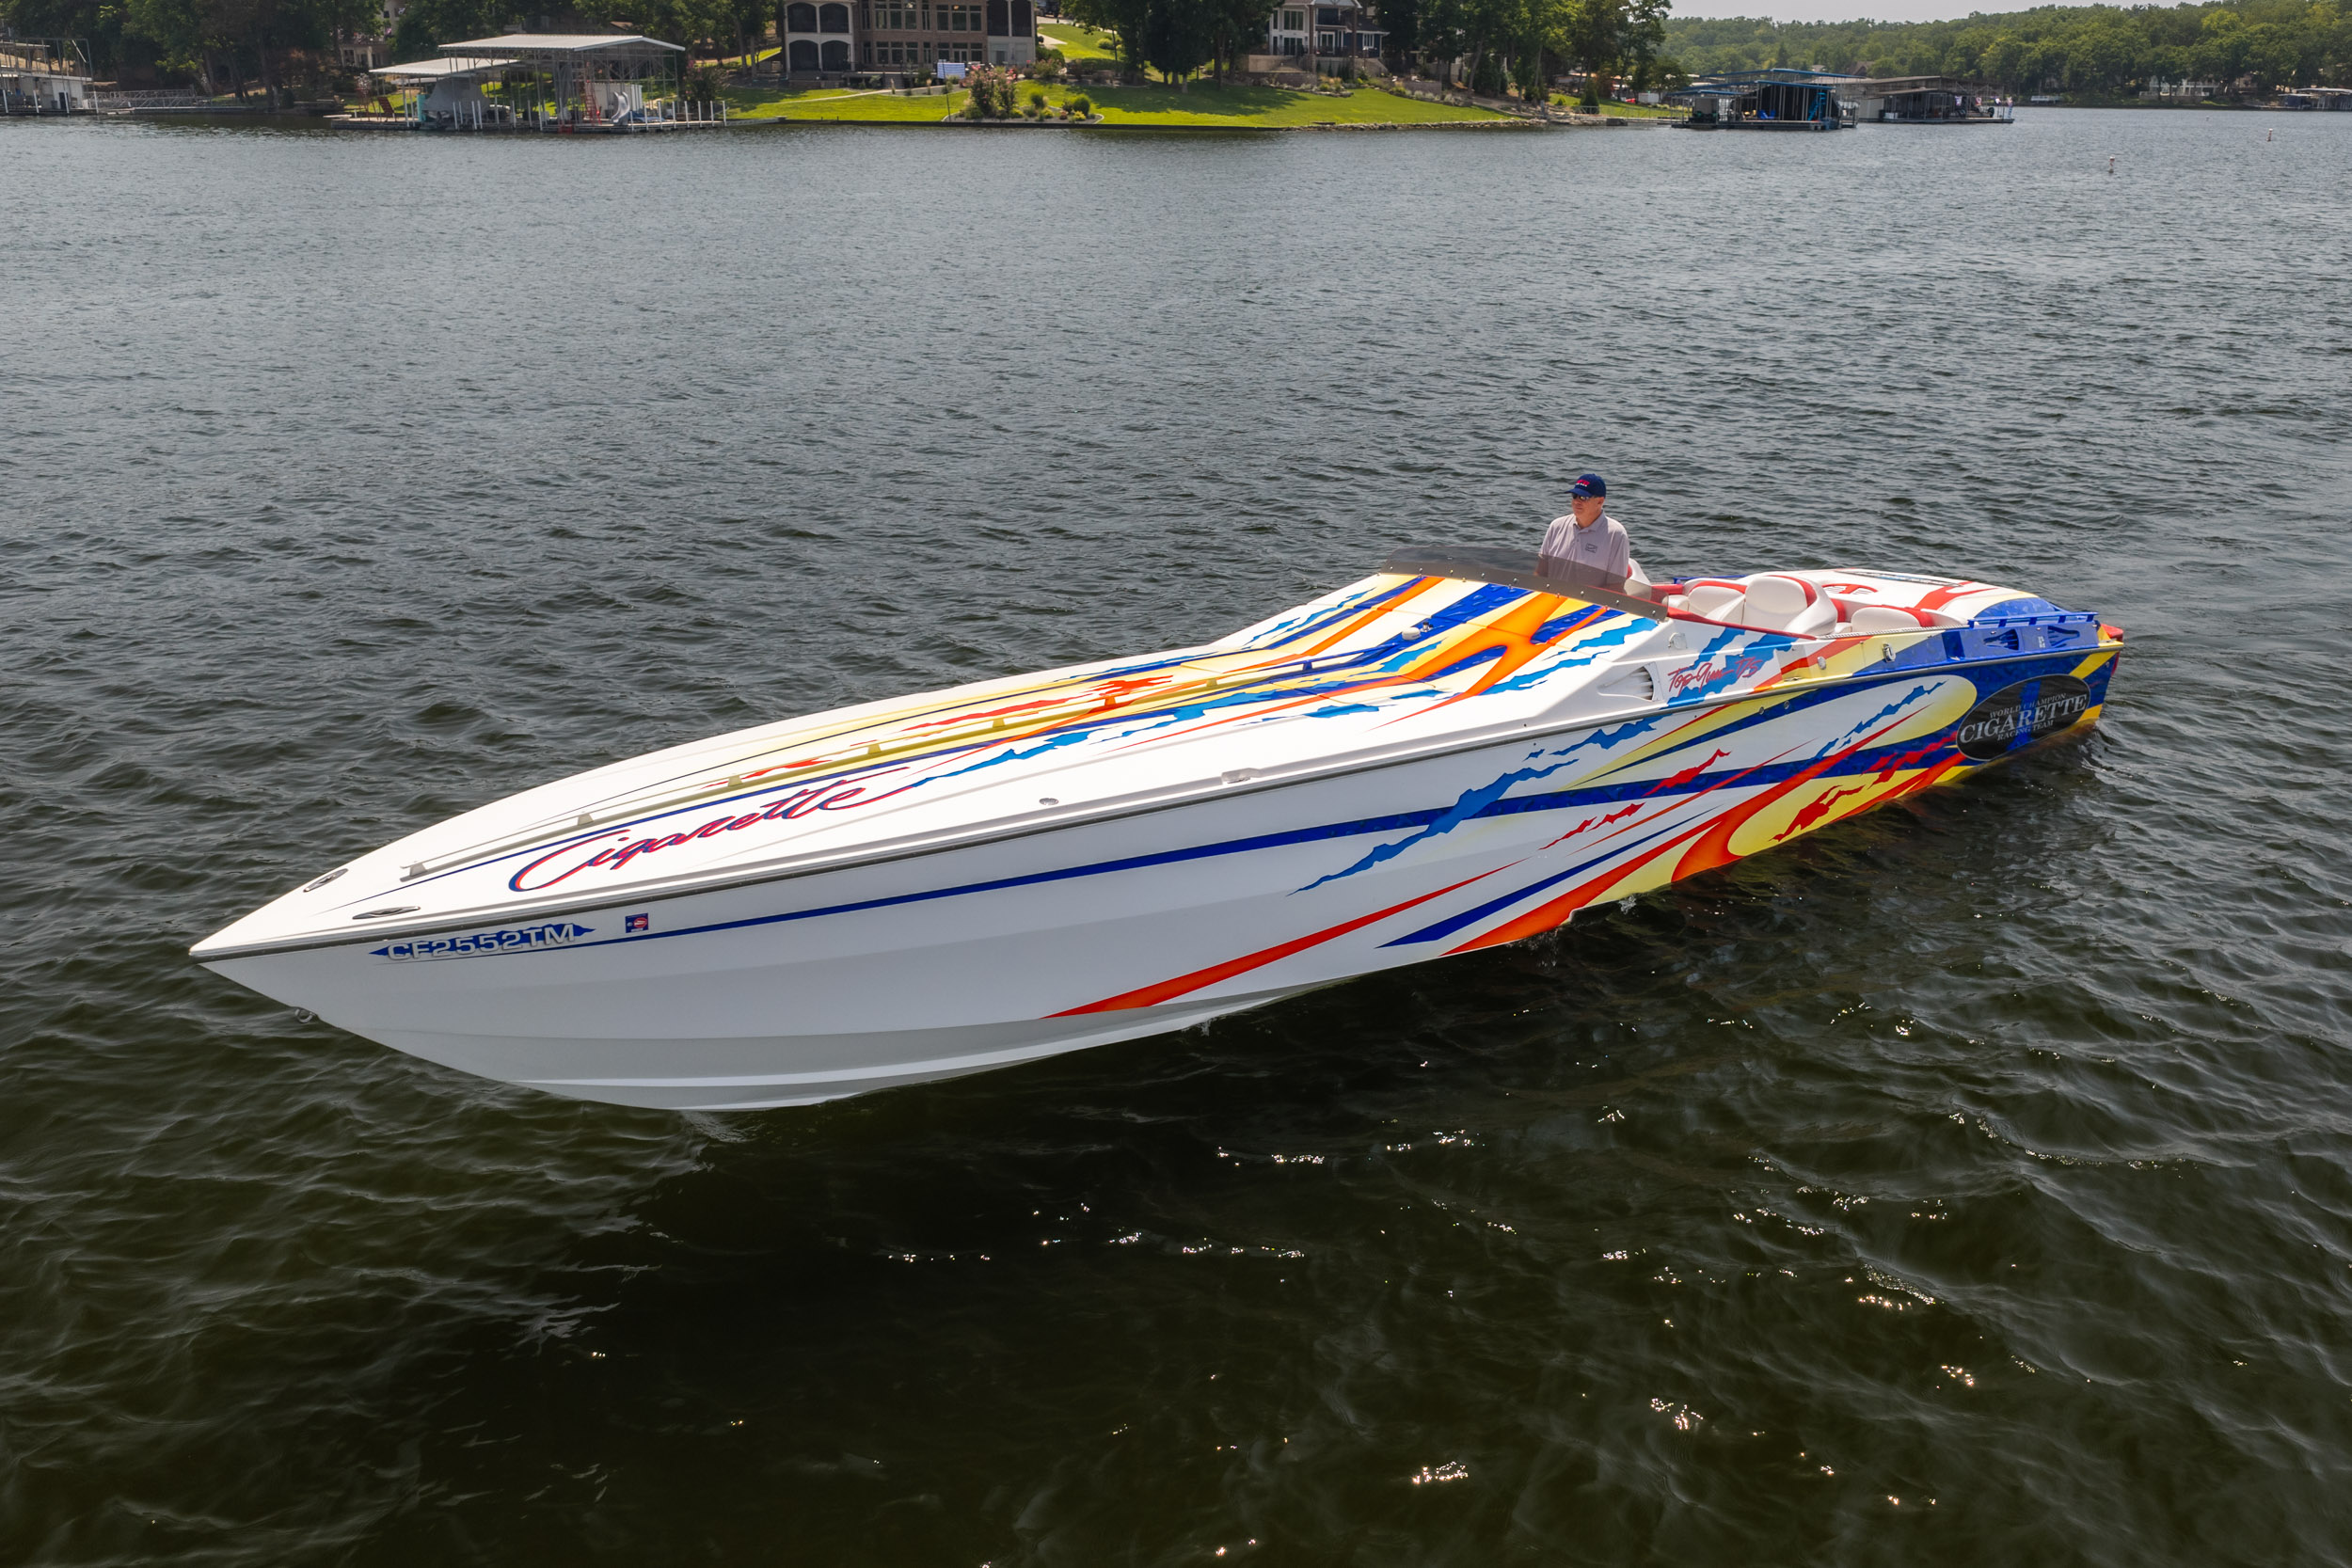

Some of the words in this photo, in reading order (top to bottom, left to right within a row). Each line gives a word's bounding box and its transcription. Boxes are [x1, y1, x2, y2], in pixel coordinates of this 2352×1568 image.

[1960, 693, 2088, 743] CIGARETTE
[1990, 705, 2021, 719] WORLD
[2023, 693, 2067, 710] CHAMPION
[1996, 725, 2031, 741] RACING
[2032, 720, 2054, 732] TEAM
[508, 767, 914, 893] Cigarette
